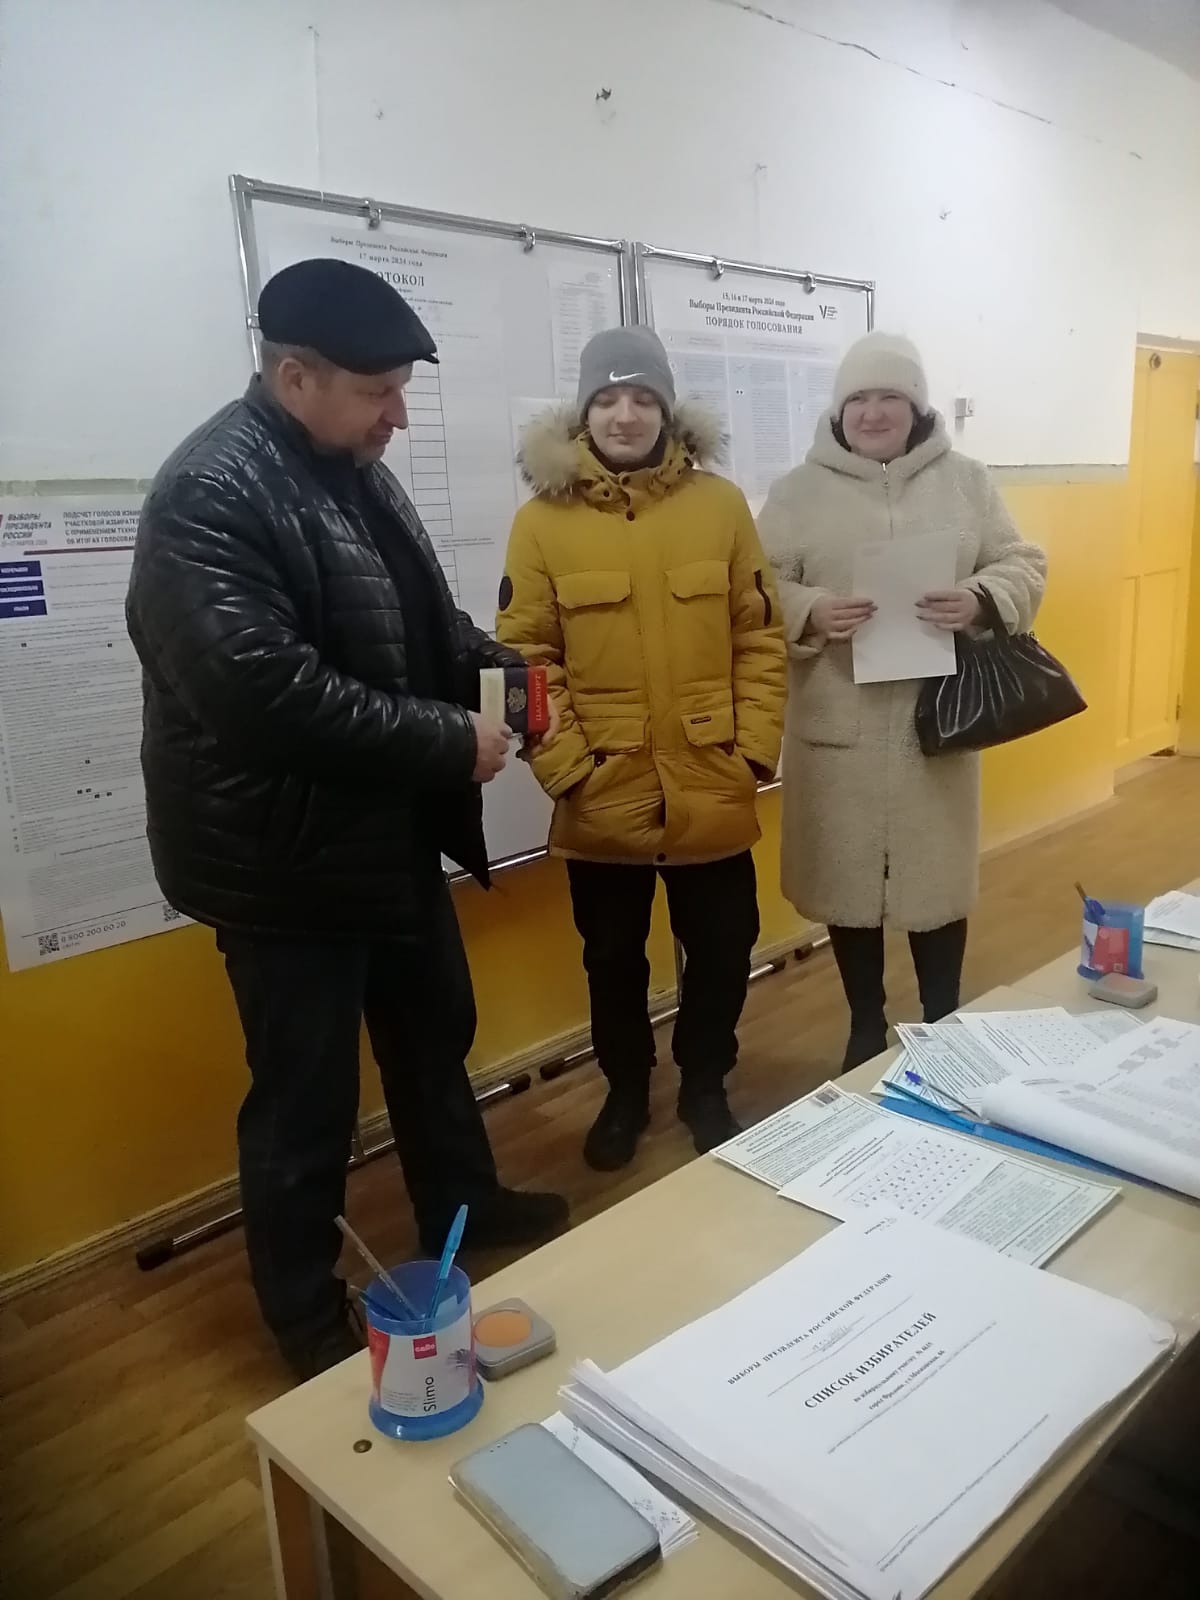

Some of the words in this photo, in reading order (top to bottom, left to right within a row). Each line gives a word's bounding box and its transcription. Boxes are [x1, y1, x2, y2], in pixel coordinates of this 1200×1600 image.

[376, 271, 425, 287] ОТОКОЛ
[689, 299, 716, 312] Выборы
[716, 302, 752, 314] Президента
[752, 306, 785, 318] Российской
[785, 310, 815, 322] Федерации
[705, 316, 744, 329] ПОРЯДОК
[746, 320, 803, 335] ГОЛОСОВАНИЯ
[8, 513, 41, 521] ВЫБОРЫ
[63, 511, 91, 519] ПОДСЧЕТ
[93, 510, 121, 518] ГОЛОСОВ
[64, 518, 105, 527] УЧАСТКОВОЙ
[5, 521, 52, 530] ПРЕЗИДЕНТА
[3, 531, 33, 540] РОССИИ
[727, 1361, 762, 1385] ВЫБОРЫ
[762, 1333, 809, 1362] ПРЕЗИДЕНТА
[807, 1299, 854, 1336] РОССИЙСКОЙ
[853, 1273, 893, 1302] ФЕДЕРАЦИИ
[804, 1371, 858, 1410] СПИСОК
[855, 1311, 937, 1376] ИЗБИРАТЕЛЕЙ
[423, 1376, 437, 1413] Slimo
